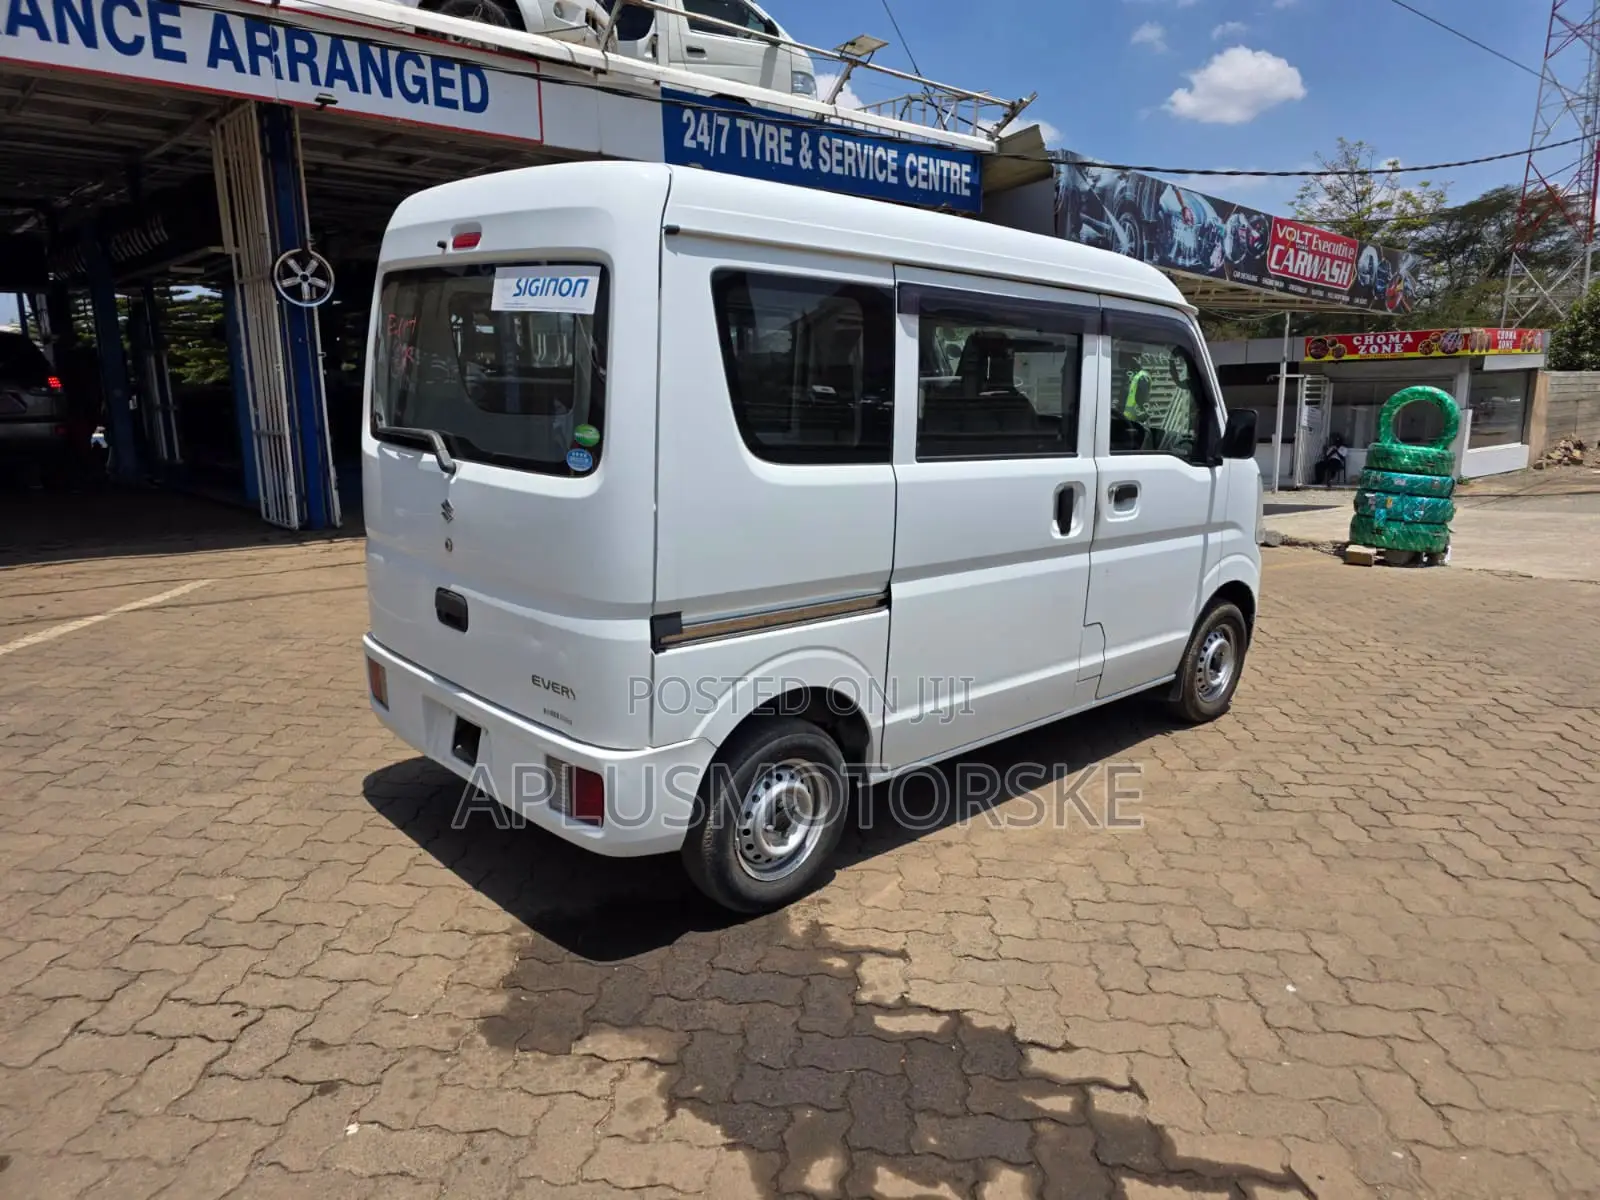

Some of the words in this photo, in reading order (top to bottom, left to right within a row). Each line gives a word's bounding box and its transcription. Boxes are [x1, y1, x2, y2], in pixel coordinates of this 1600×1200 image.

[0, 0, 188, 64] ANCE
[207, 12, 490, 115] ARRANGED
[682, 108, 730, 157] 24/7
[735, 118, 794, 166] TYRE
[799, 131, 813, 170] &
[818, 137, 899, 185] SERVICE
[905, 153, 971, 197] CENTRE
[1276, 223, 1313, 246] VOLT
[1270, 244, 1352, 286] CARWASH
[1352, 332, 1414, 346] CHOMA
[1358, 343, 1405, 355] ZONE
